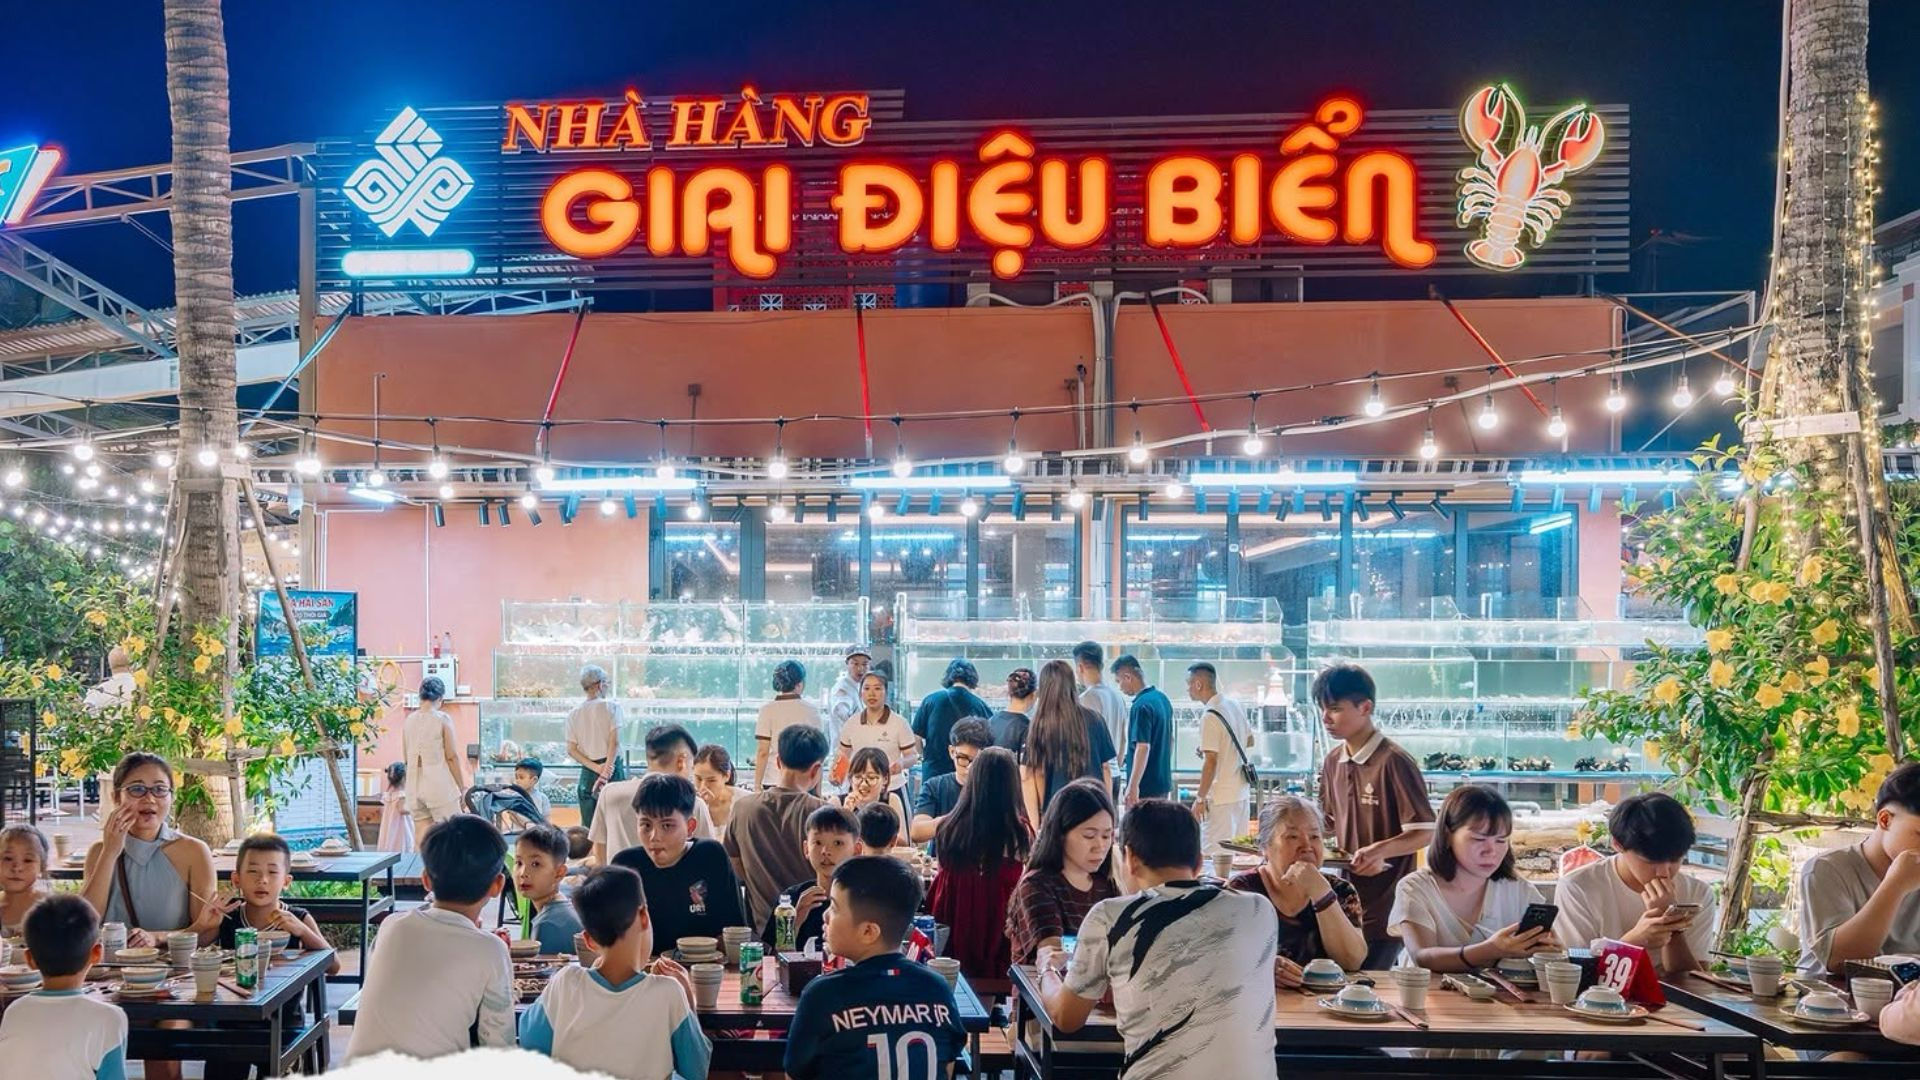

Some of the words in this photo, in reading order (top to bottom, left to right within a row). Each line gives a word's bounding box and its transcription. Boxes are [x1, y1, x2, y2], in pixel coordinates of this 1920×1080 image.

[502, 90, 652, 154] NHÀ
[665, 88, 871, 149] HÀNG
[541, 166, 791, 278] GIAI
[831, 130, 1109, 279] ĐIỆU
[1146, 97, 1437, 269] BIỂN
[1598, 953, 1632, 993] 39
[832, 1004, 932, 1033] NEYMAR
[867, 1031, 938, 1080] 10
